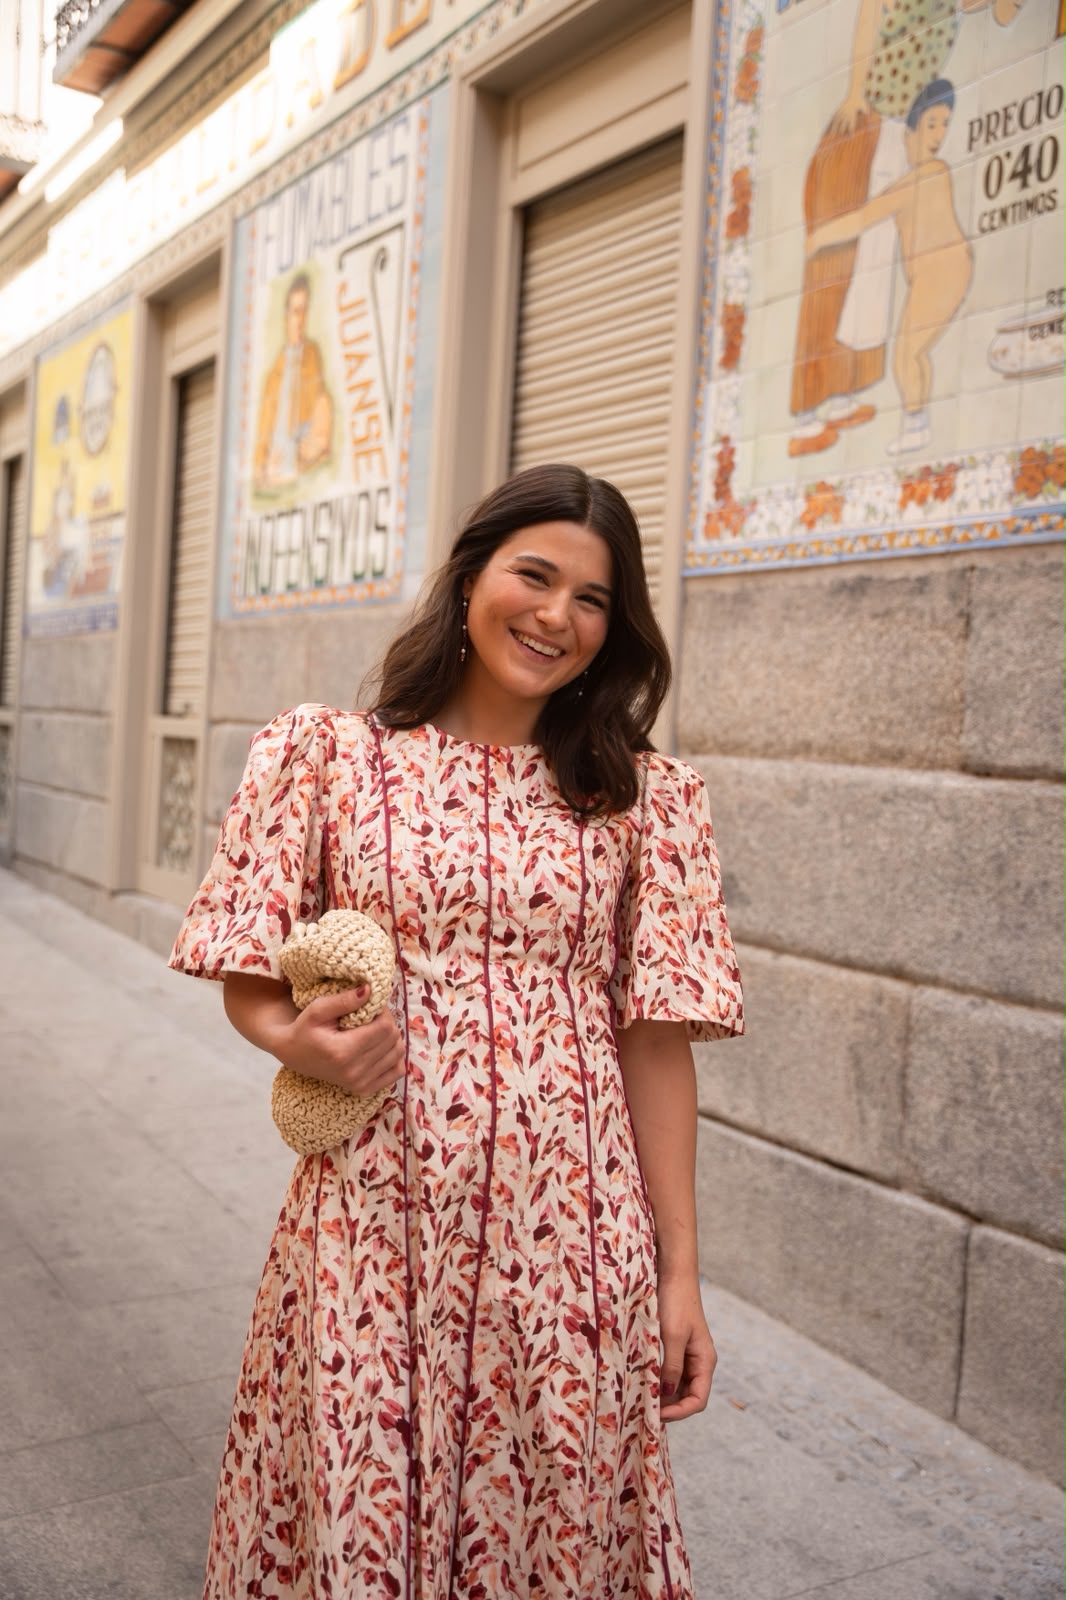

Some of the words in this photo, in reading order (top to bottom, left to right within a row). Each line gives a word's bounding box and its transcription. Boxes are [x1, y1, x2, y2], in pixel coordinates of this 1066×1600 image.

[967, 83, 1064, 152] PRECIO
[257, 114, 410, 286] FUMABLES
[978, 188, 1058, 234] CENTIMOS
[337, 281, 387, 486] JUANSE
